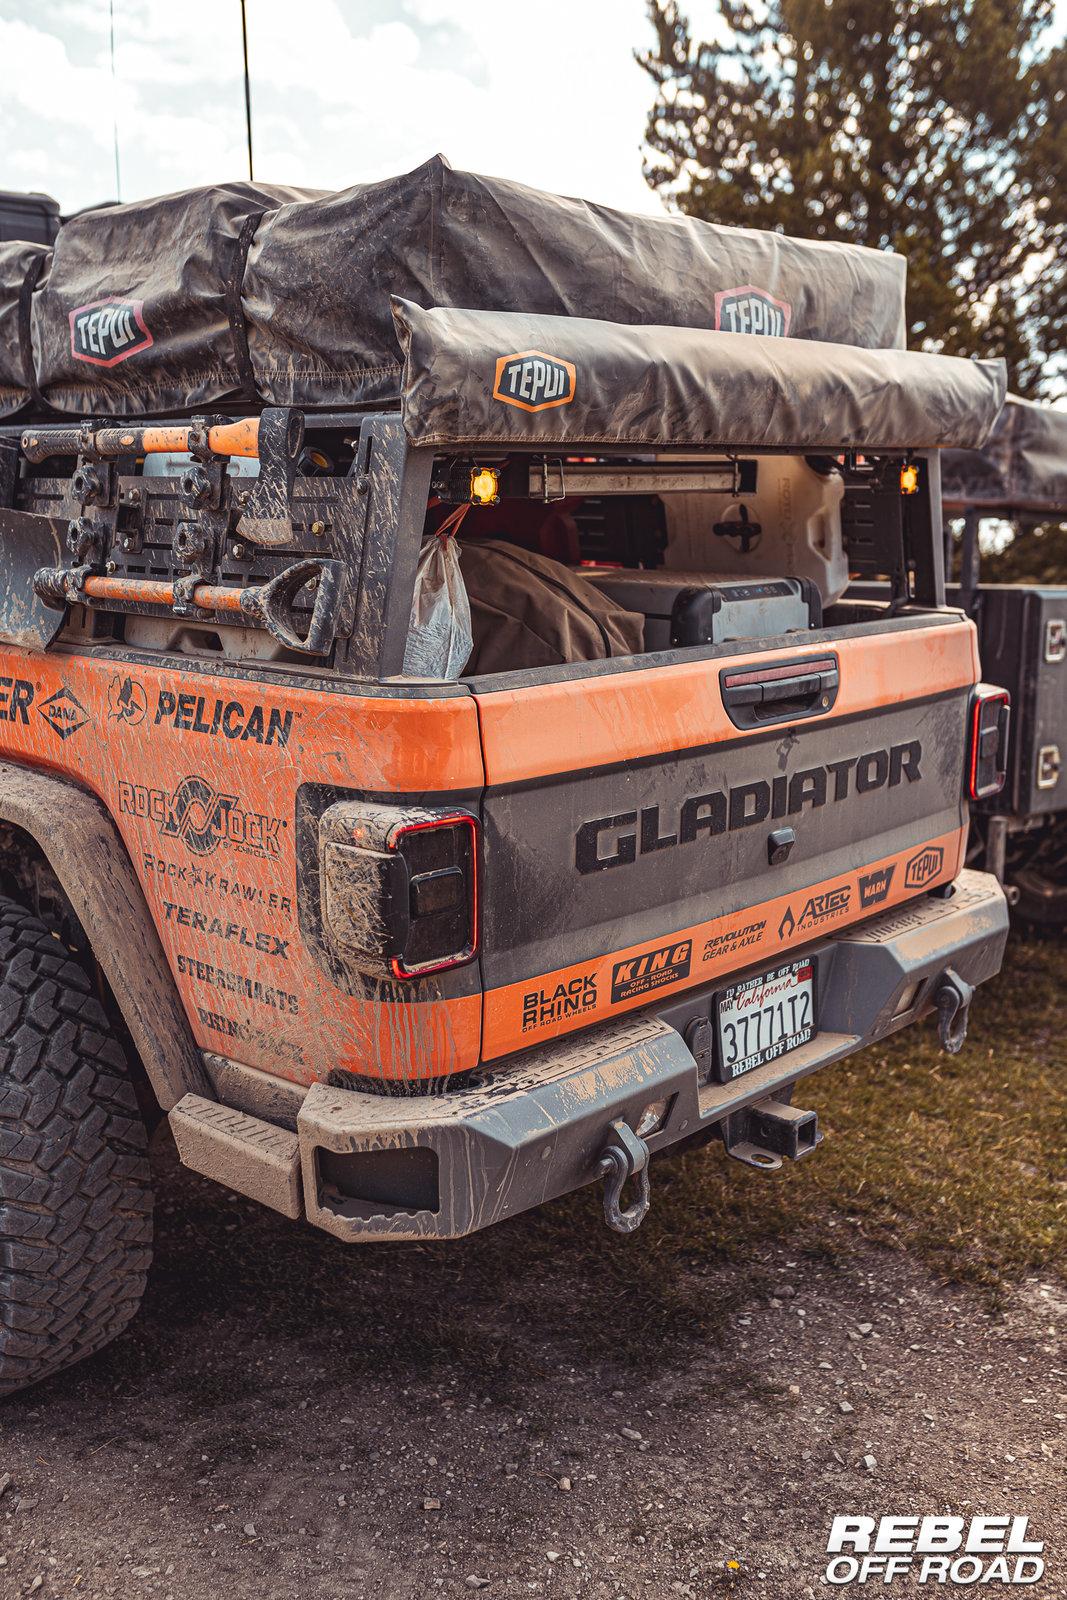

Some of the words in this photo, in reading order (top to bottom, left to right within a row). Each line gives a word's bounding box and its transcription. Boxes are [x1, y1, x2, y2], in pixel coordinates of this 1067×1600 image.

[77, 308, 136, 355] TEPUI
[508, 360, 565, 402] TEPUI
[49, 704, 77, 721] DANA
[154, 690, 294, 748] PELICAN
[574, 739, 923, 876] GLADIATOR
[143, 853, 187, 881] ROCK
[911, 852, 938, 881] TEPUI
[797, 885, 851, 925] ARTEC
[864, 879, 887, 899] WARN
[163, 901, 289, 960] TERAFLEX
[704, 919, 767, 950] REVOLUTION
[797, 907, 850, 932] INDUSTRIES
[614, 943, 691, 985] KING
[702, 944, 729, 962] GEAR
[729, 941, 737, 952] &
[738, 932, 764, 951] AXLE
[523, 972, 598, 1011] BLACK
[620, 983, 649, 998] RACING
[650, 972, 679, 989] SHOCKS
[737, 976, 763, 994] RATHER
[766, 972, 776, 982] BE
[778, 966, 790, 977] OFF
[792, 958, 810, 972] ROAD
[522, 989, 598, 1028] RHINO
[720, 997, 734, 1014] MAY
[736, 977, 799, 1010] California
[522, 1024, 538, 1033] OFF
[540, 1016, 562, 1027] ROAD
[565, 1004, 597, 1019] WHEELS
[723, 990, 811, 1064] 37771T2
[731, 1052, 764, 1078] REBEL
[765, 1041, 785, 1063] OFF
[786, 1028, 811, 1051] ROAD
